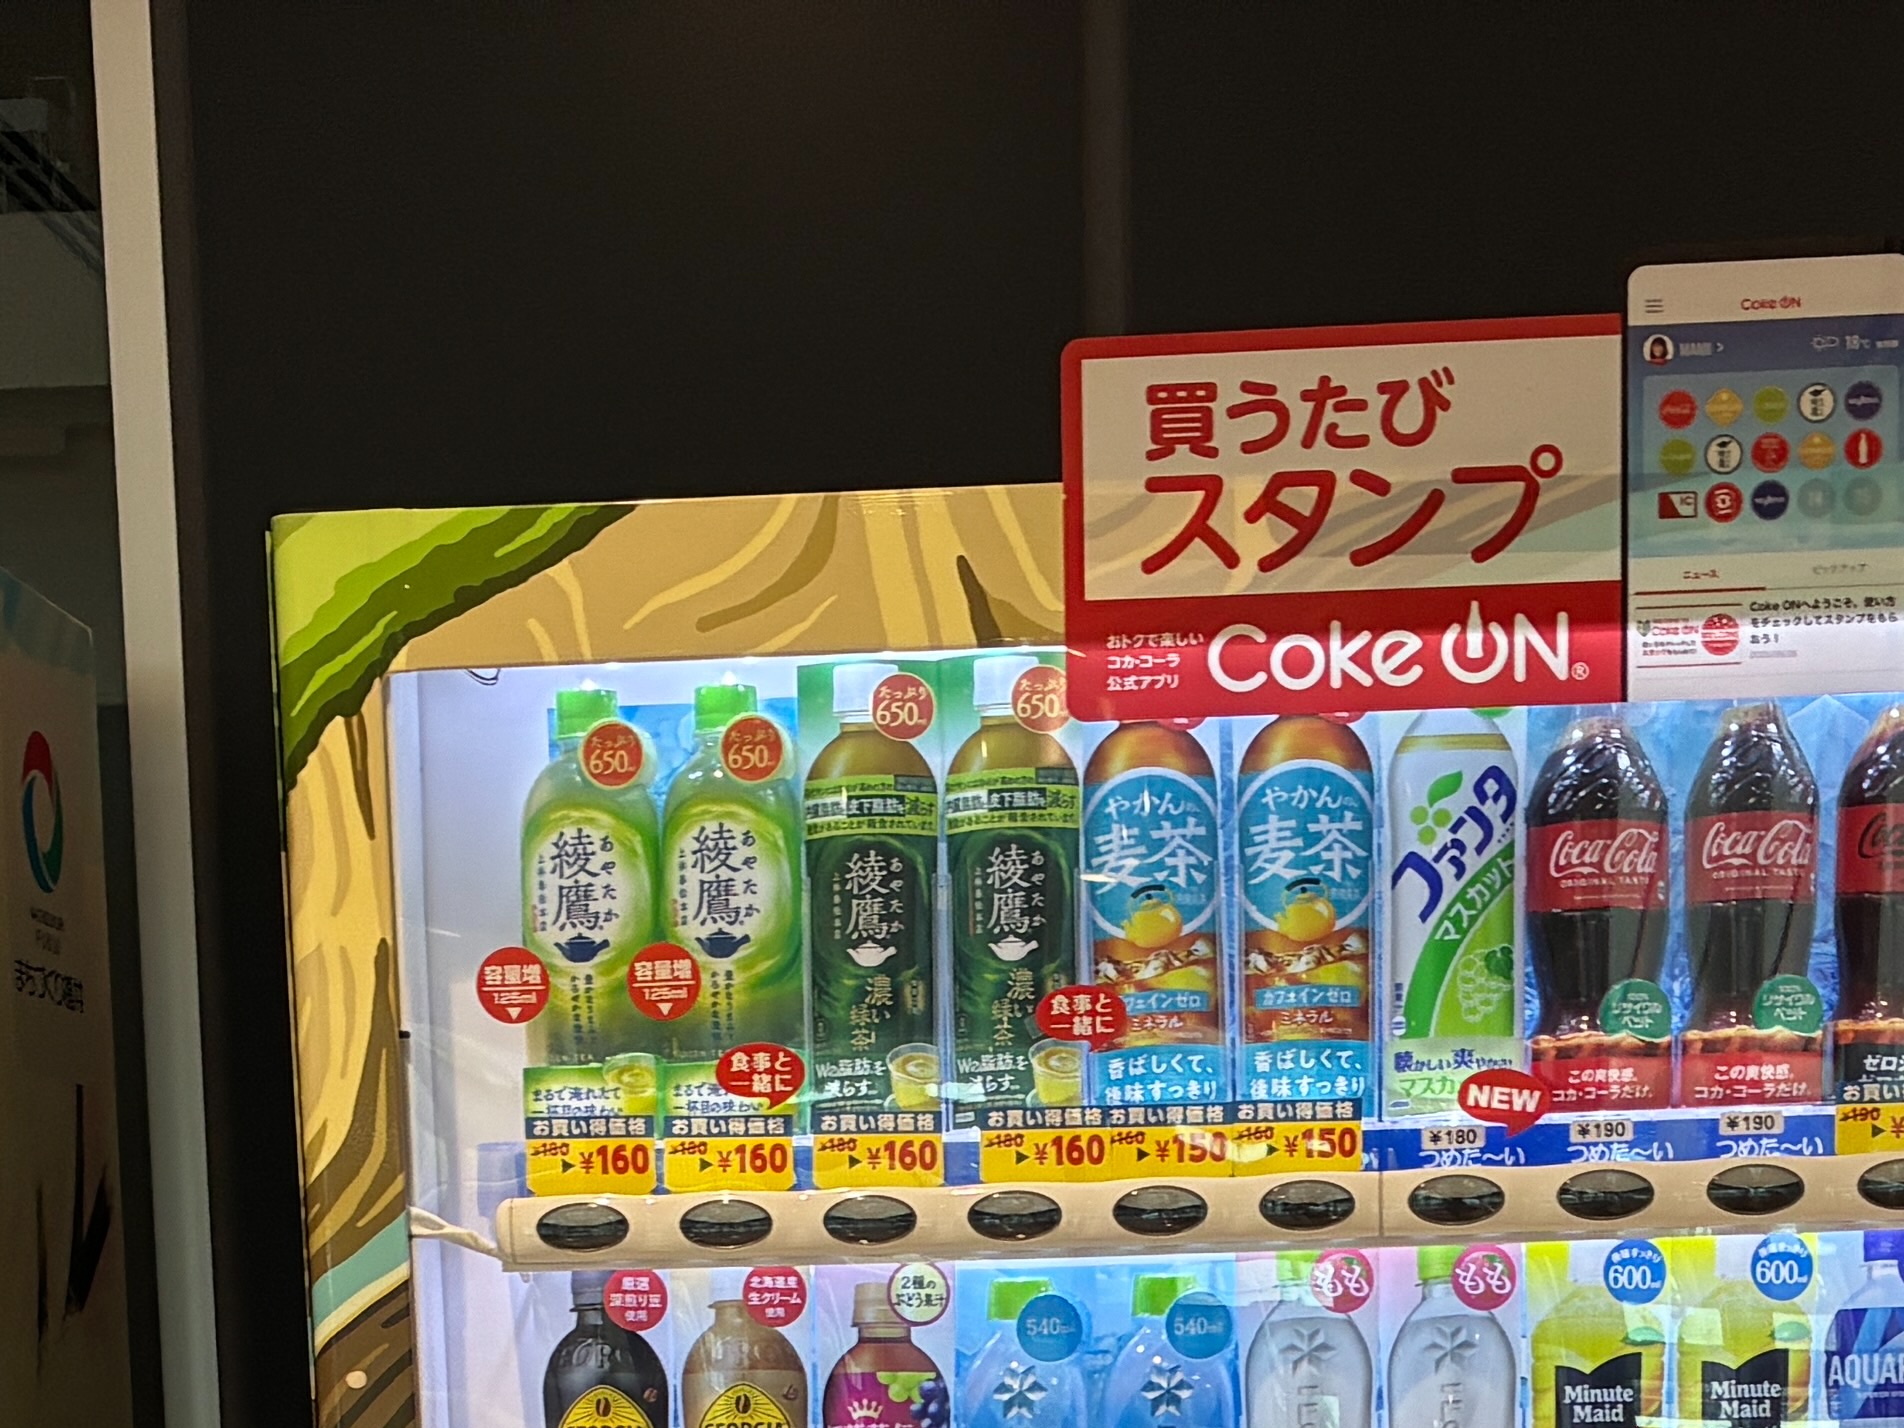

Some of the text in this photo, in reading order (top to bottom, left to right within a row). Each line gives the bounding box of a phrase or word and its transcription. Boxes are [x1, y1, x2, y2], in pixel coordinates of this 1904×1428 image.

[1145, 366, 1455, 461] 買うたび
[1141, 442, 1564, 576] スタンプ
[1207, 620, 1408, 693] Coke
[1106, 673, 1180, 691] 公式アプリ
[1245, 812, 1369, 885] 麦茶
[1391, 764, 1518, 924] ファンタ
[1550, 828, 1659, 878] Coca-Cola
[1702, 820, 1812, 870] Coca-Cola
[730, 1051, 794, 1073] 食事と
[730, 1074, 794, 1095] 一緒に
[1250, 1076, 1364, 1099] 後味すっきり
[1468, 1083, 1542, 1113] NEW
[533, 1116, 647, 1136] お買い得価格
[821, 1113, 934, 1133] お買い得価格
[1577, 1122, 1625, 1138] ¥190
[1726, 1114, 1775, 1131] ¥190
[1429, 1128, 1478, 1145] ¥180
[579, 1143, 650, 1176] ¥160
[867, 1139, 938, 1174] ¥160
[1564, 1384, 1634, 1404] Minute
[1572, 1404, 1624, 1424] Maid
